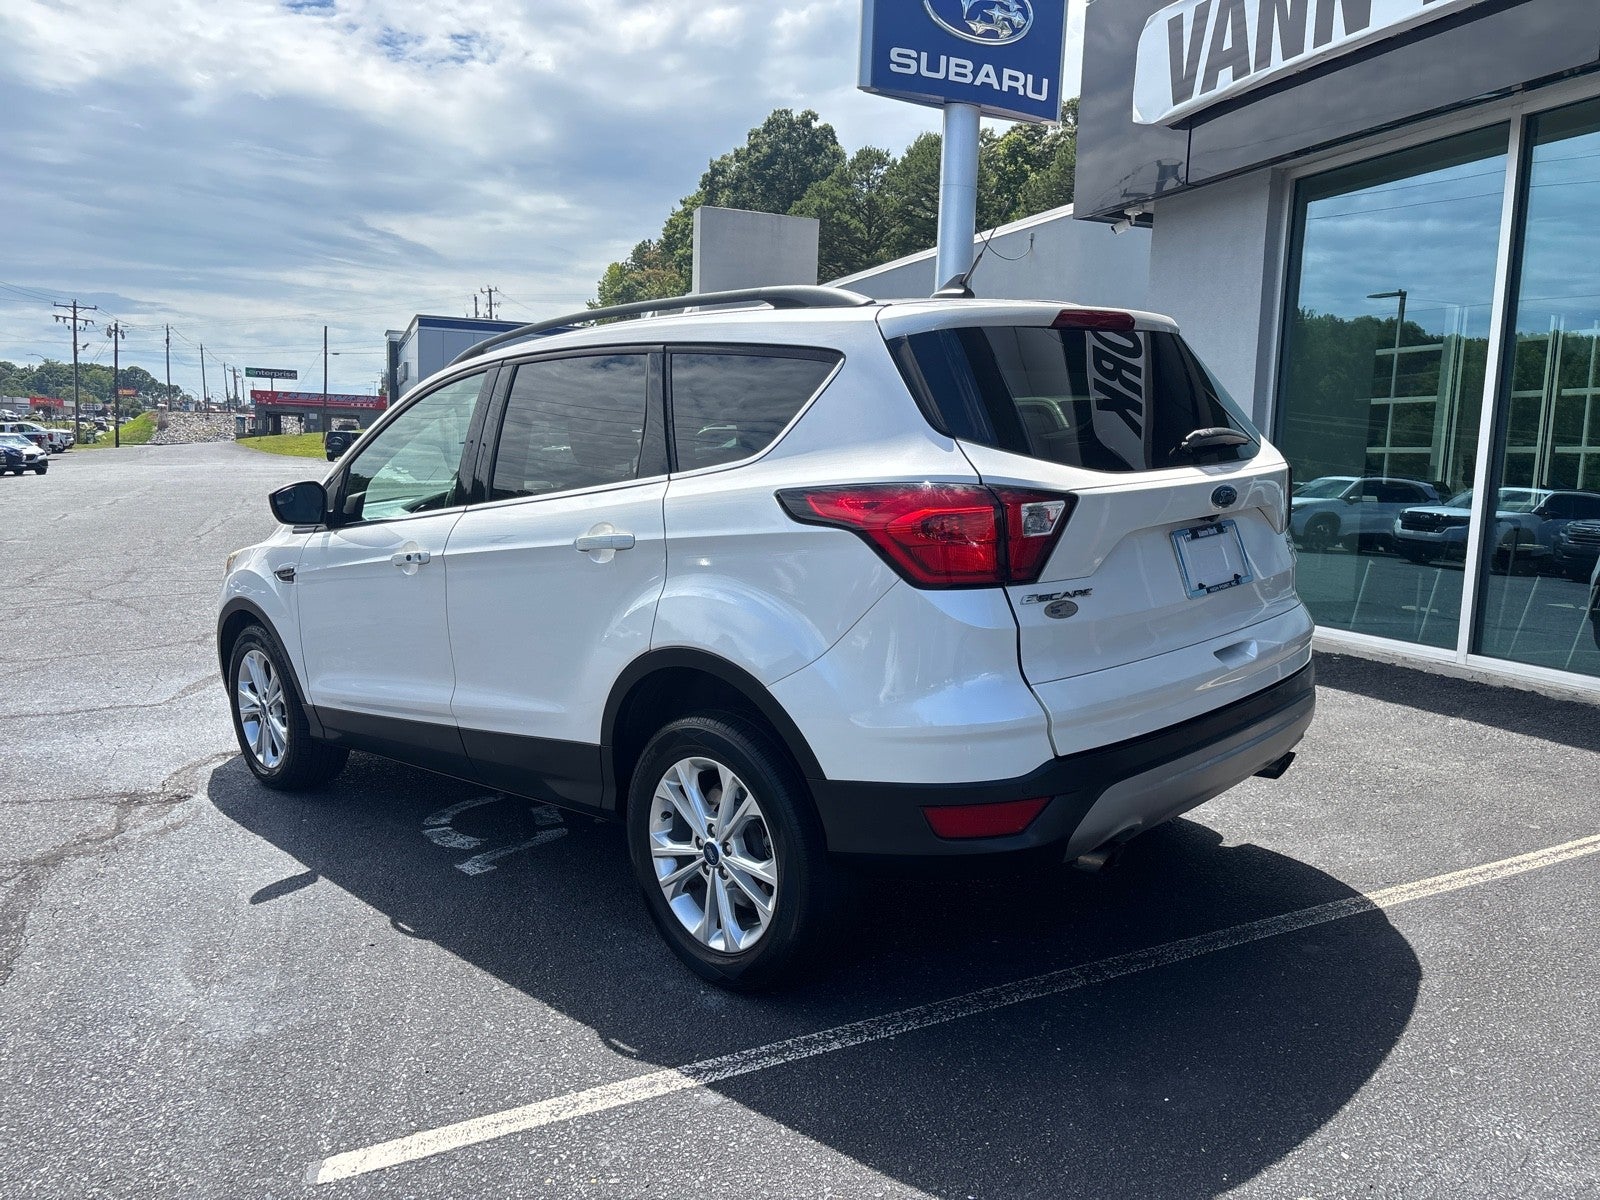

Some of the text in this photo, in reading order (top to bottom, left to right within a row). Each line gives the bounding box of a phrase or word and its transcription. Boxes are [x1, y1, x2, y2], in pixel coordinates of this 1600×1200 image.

[1167, 0, 1371, 107] VANN
[889, 47, 1049, 101] SUBARU
[247, 369, 297, 379] enterprise
[1020, 588, 1093, 606] ESCAPE
